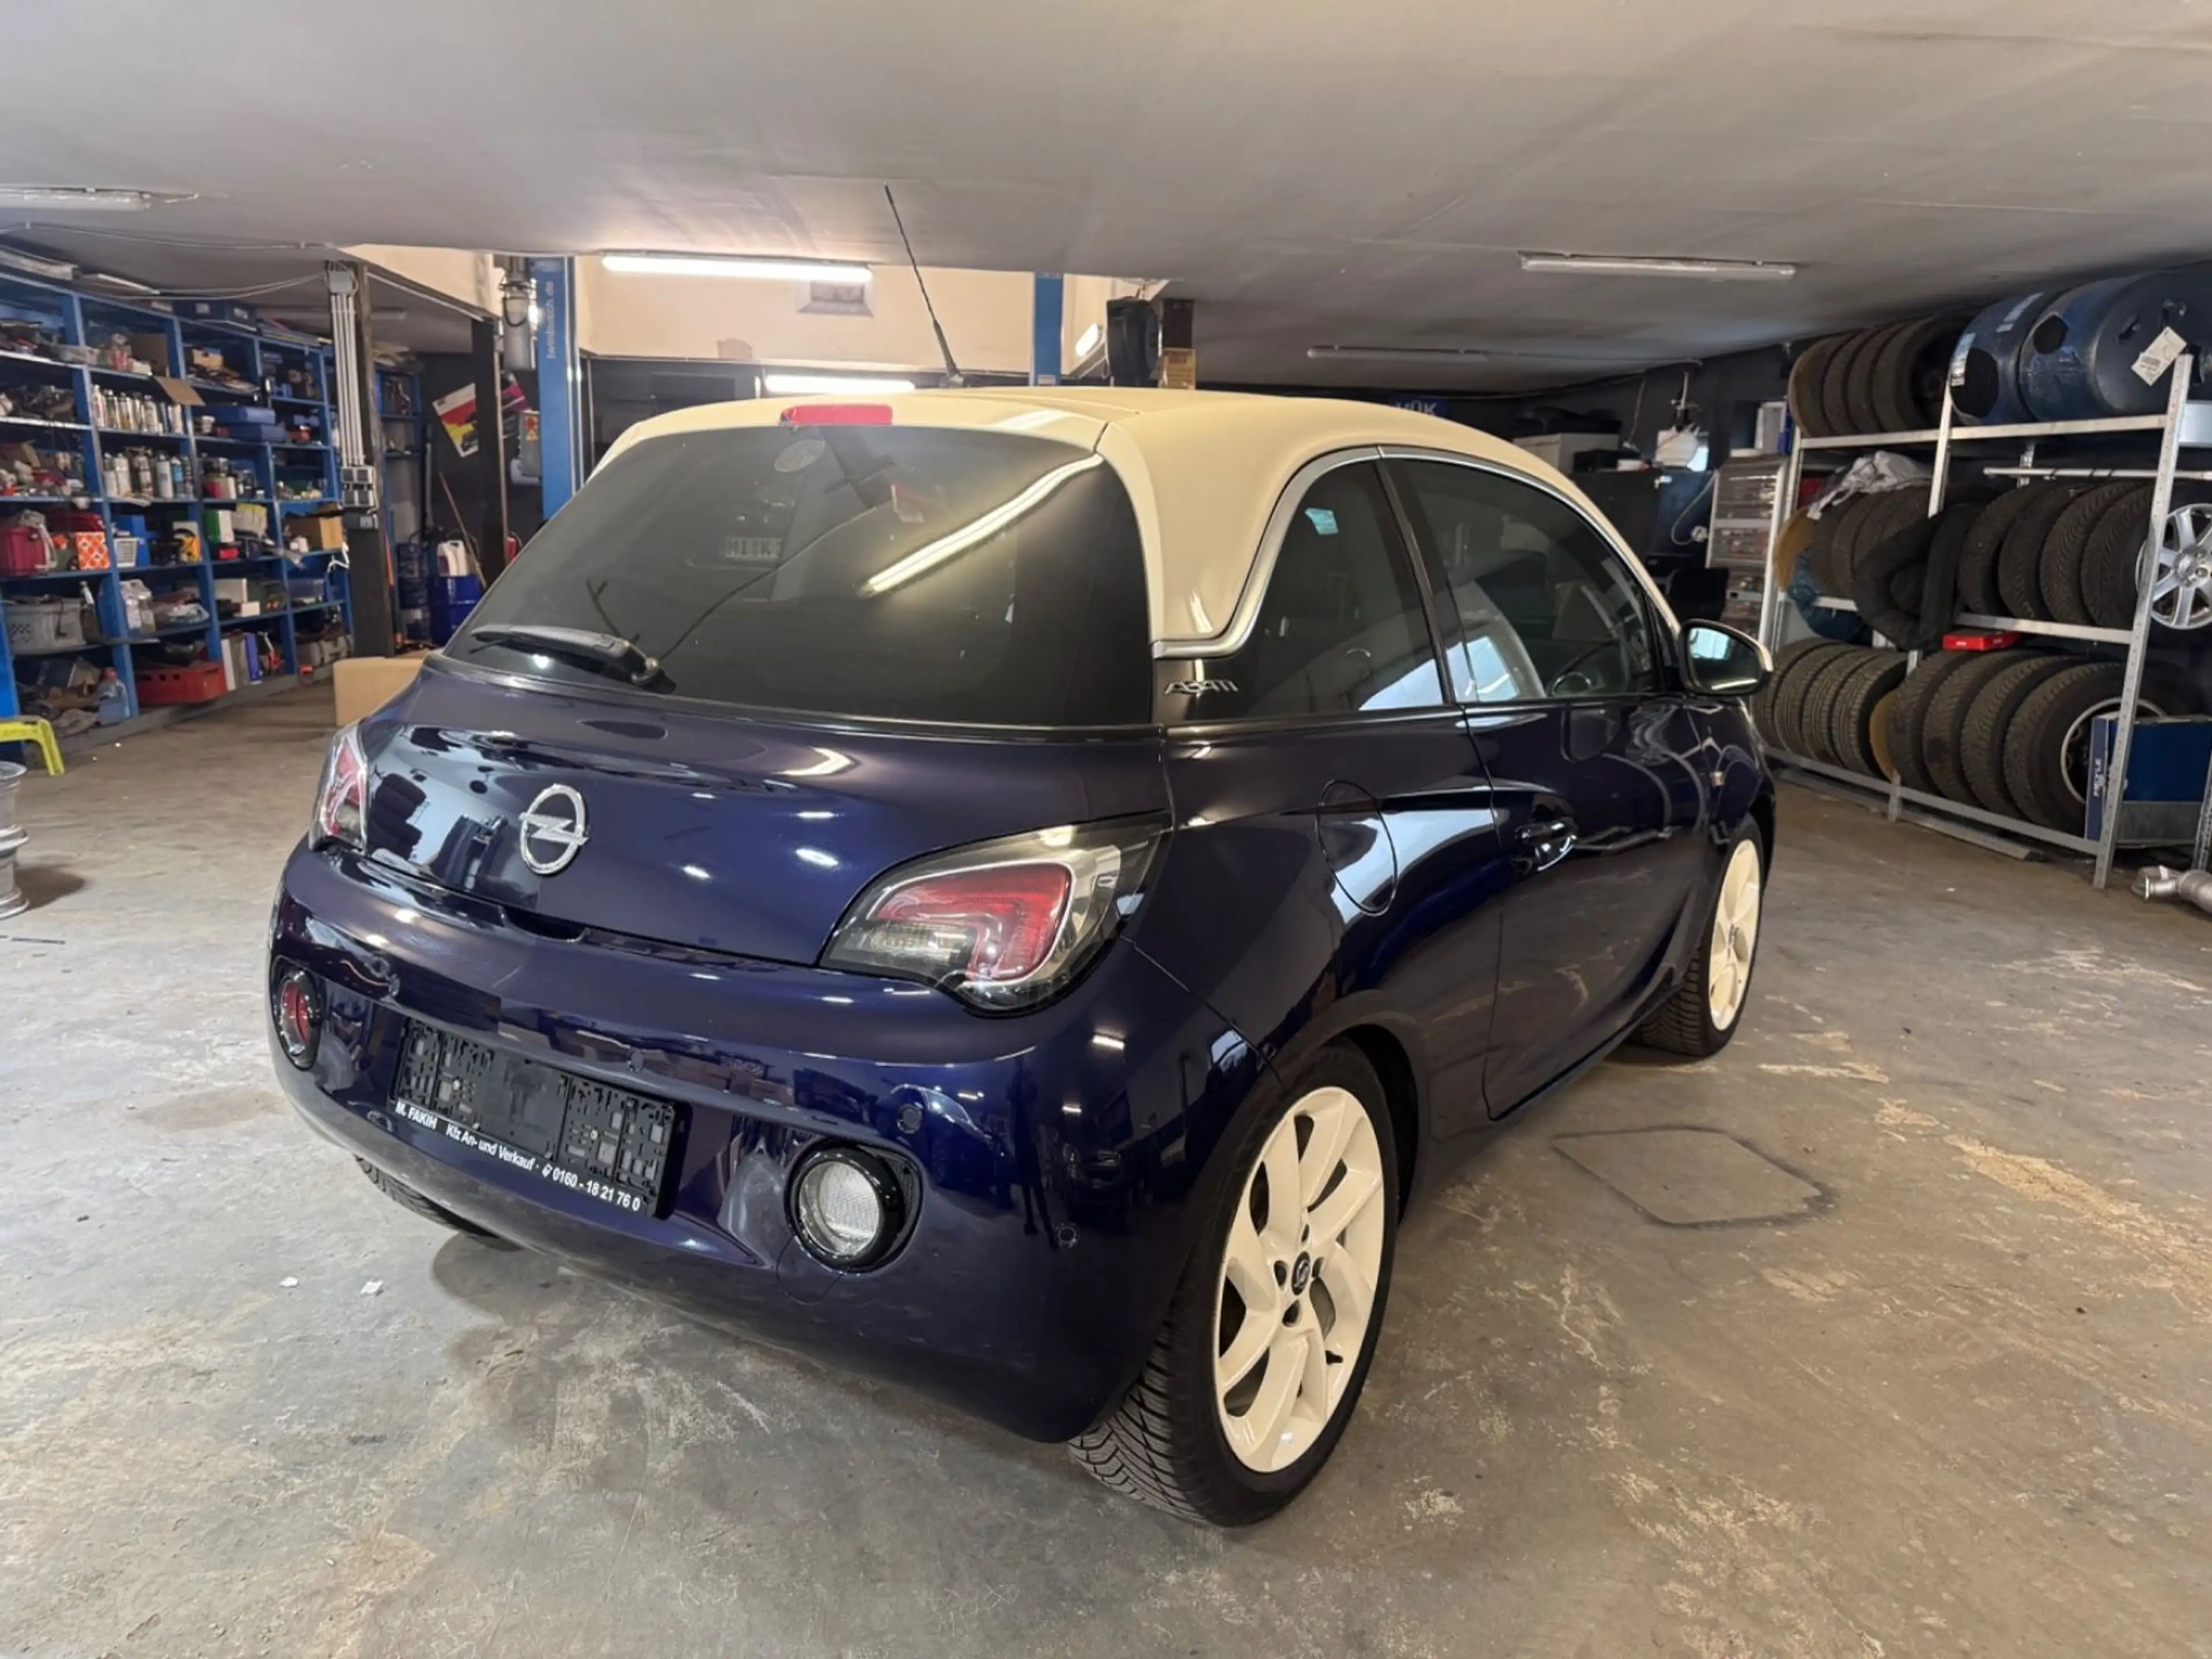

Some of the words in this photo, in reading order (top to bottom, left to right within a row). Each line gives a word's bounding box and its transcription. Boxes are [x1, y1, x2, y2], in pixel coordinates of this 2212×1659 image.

[478, 1140, 498, 1156] und
[499, 1144, 536, 1171] Verkauf
[586, 1180, 600, 1196] 18
[600, 1185, 615, 1202] 21
[616, 1191, 631, 1208] 76
[632, 1196, 641, 1211] 0
